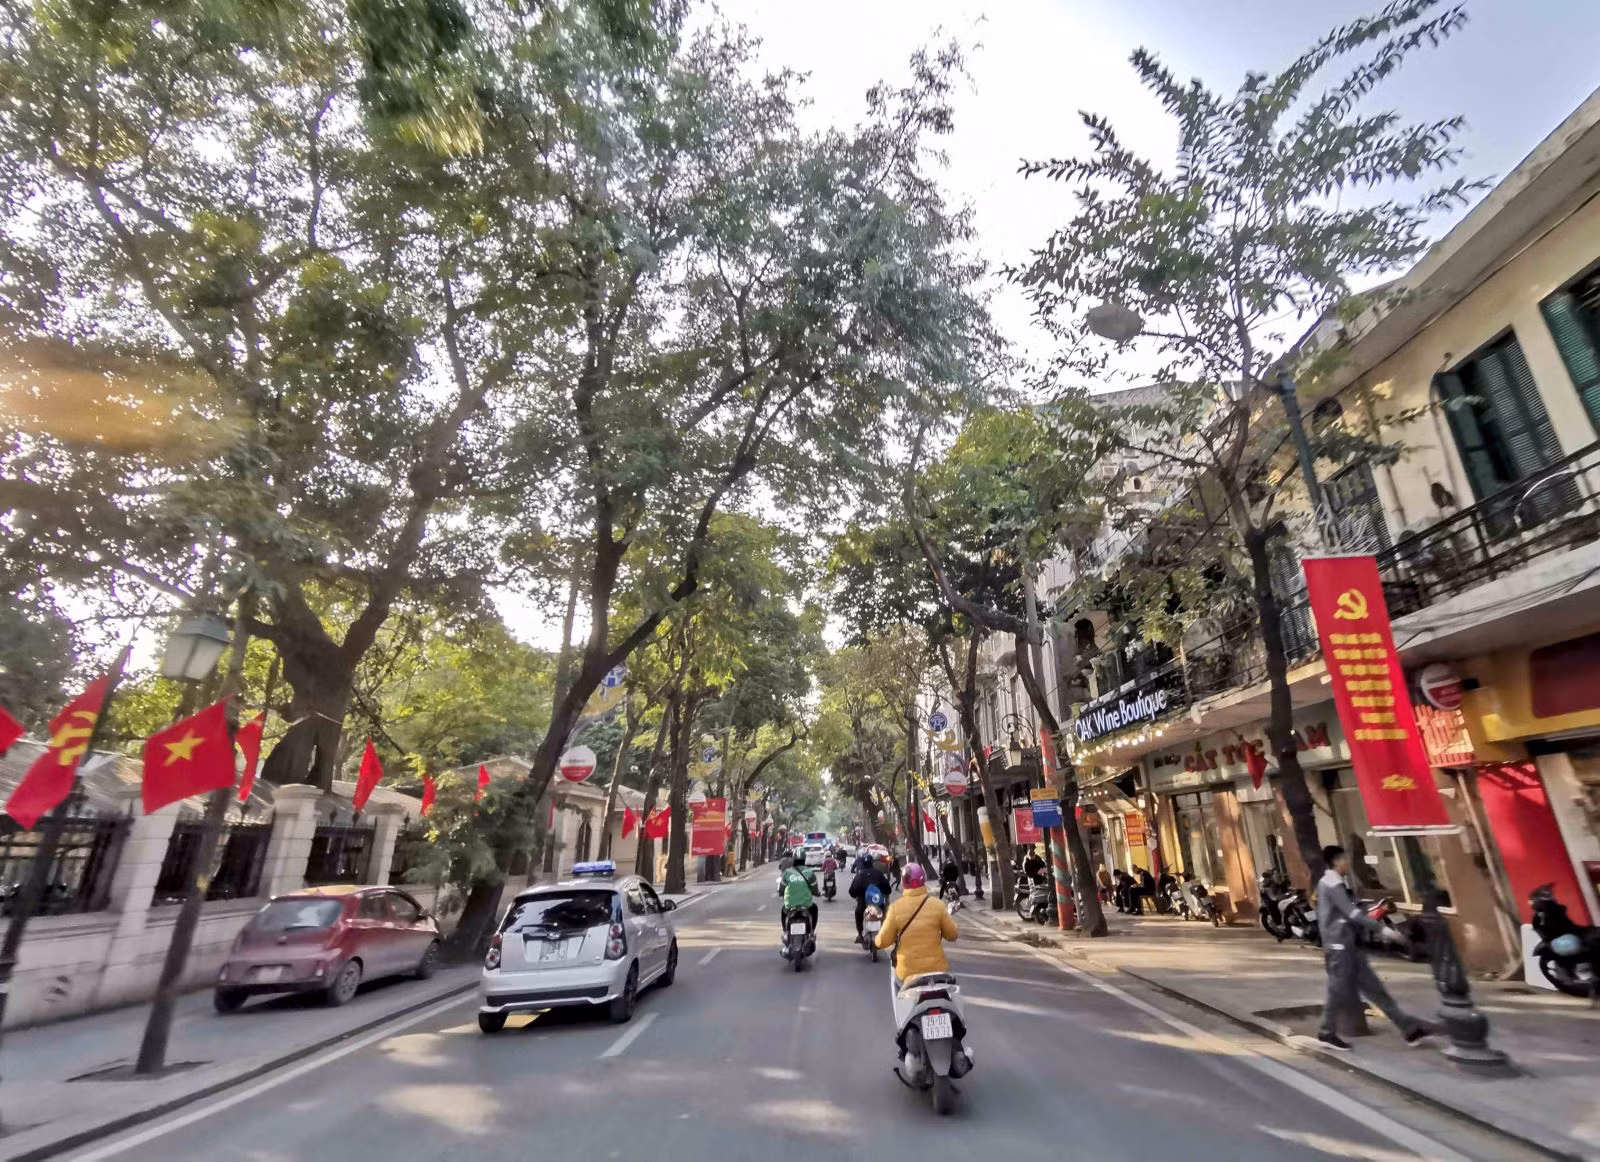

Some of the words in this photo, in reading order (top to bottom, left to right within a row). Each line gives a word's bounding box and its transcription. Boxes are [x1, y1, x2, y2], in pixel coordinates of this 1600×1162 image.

[1075, 714, 1094, 742] OAK
[1093, 707, 1121, 734] Wine
[1119, 689, 1167, 721] Boutique
